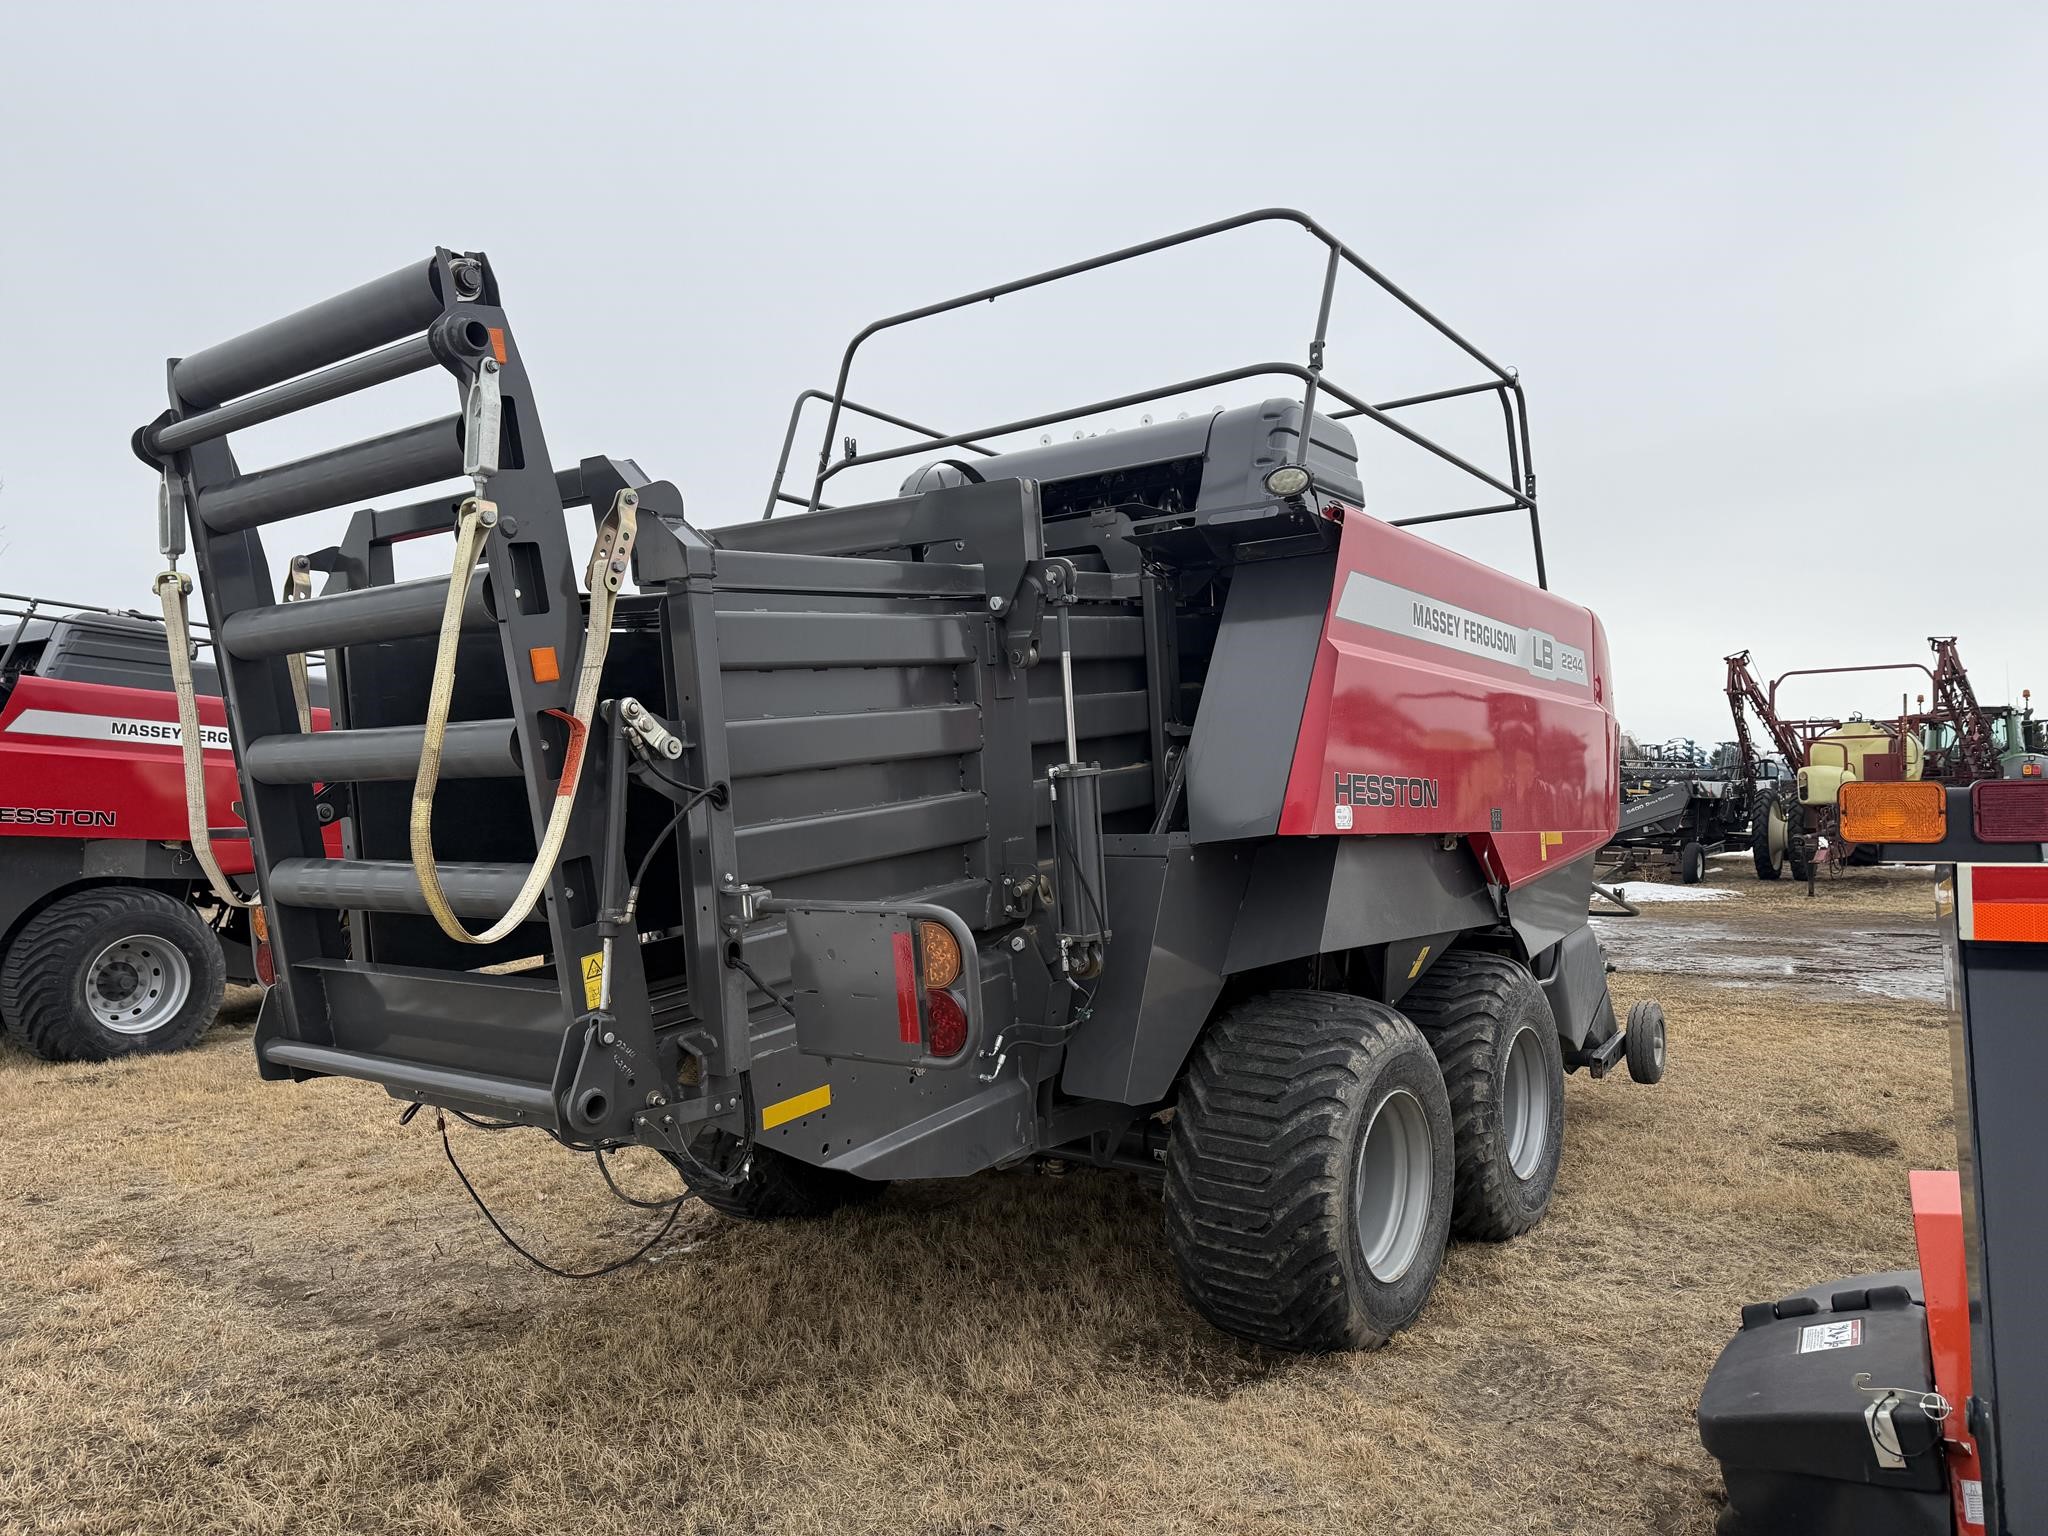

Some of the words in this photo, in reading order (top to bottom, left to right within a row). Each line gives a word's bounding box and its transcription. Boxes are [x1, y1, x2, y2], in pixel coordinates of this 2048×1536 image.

[1412, 602, 1461, 638] MASSEY
[1463, 618, 1517, 656] FERGUSON
[1532, 634, 1554, 672] LB
[1561, 652, 1584, 673] 2244
[111, 722, 182, 740] MASSEY
[1334, 771, 1439, 808] HESSTON
[0, 806, 116, 827] ESSTON
